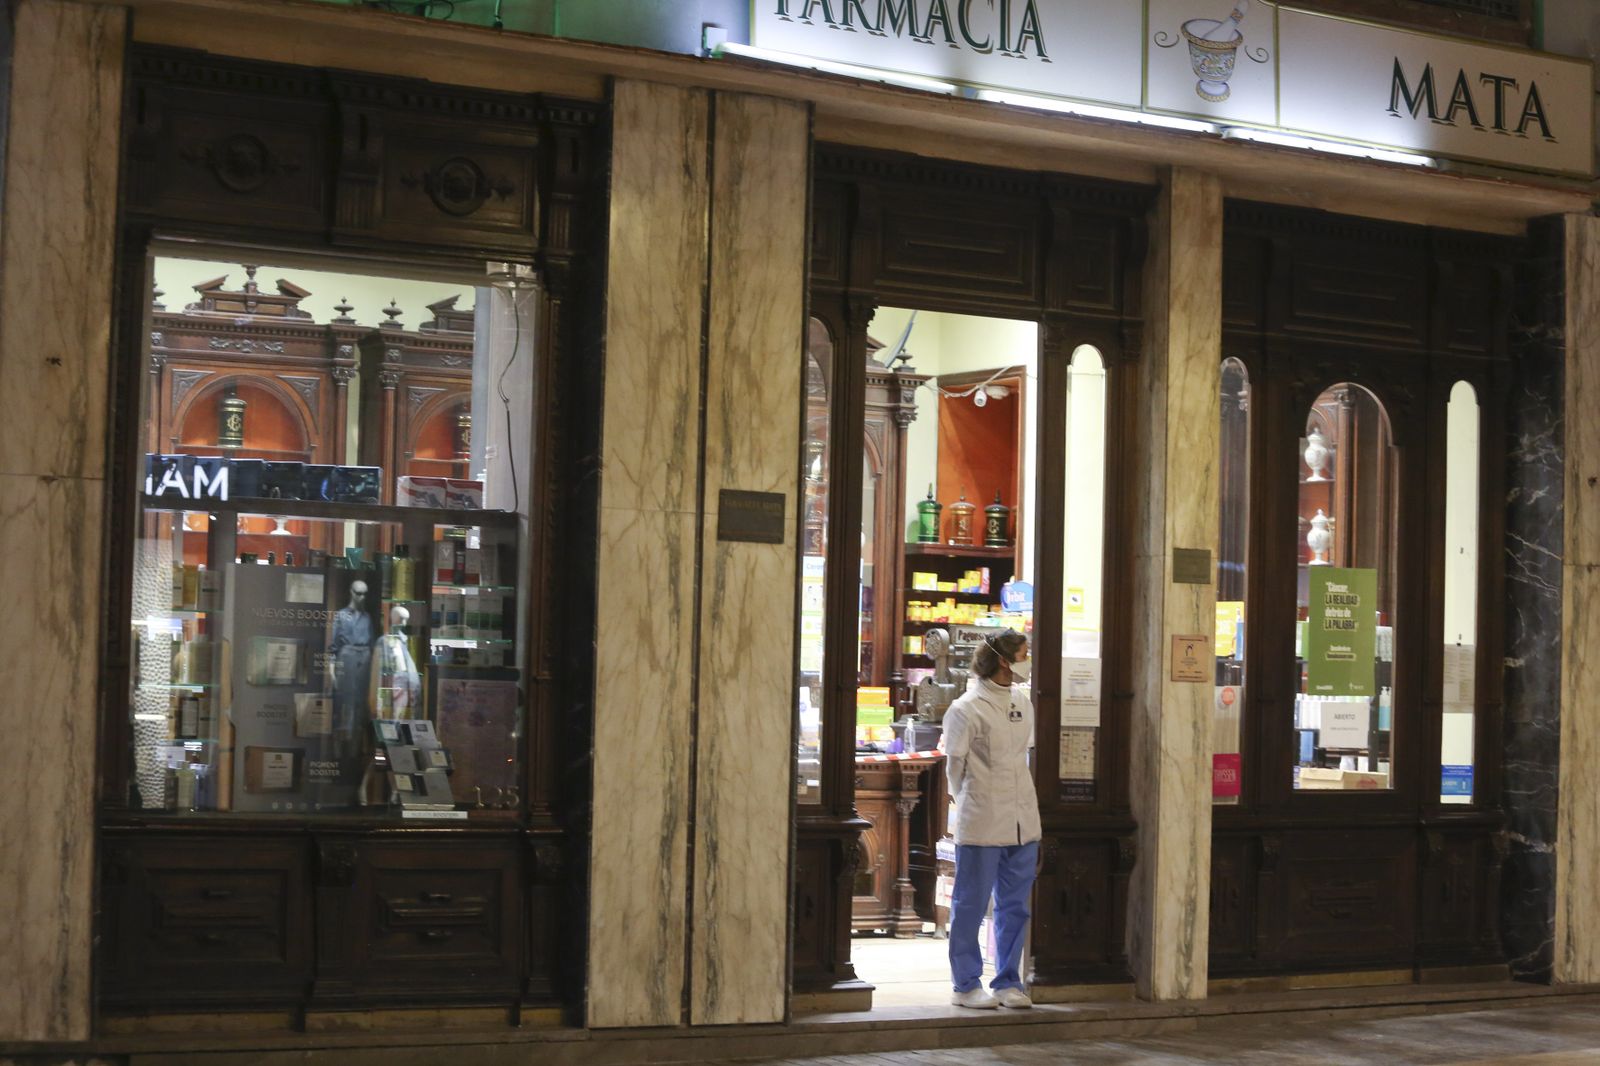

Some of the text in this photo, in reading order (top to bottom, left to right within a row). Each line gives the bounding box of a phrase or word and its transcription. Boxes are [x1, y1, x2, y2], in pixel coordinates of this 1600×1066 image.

[774, 0, 1050, 60] MACIA
[1386, 56, 1557, 142] MATA
[298, 609, 353, 620] BOOSTERS
[1334, 713, 1355, 721] ABIERTO
[310, 761, 339, 769] PIGMENT
